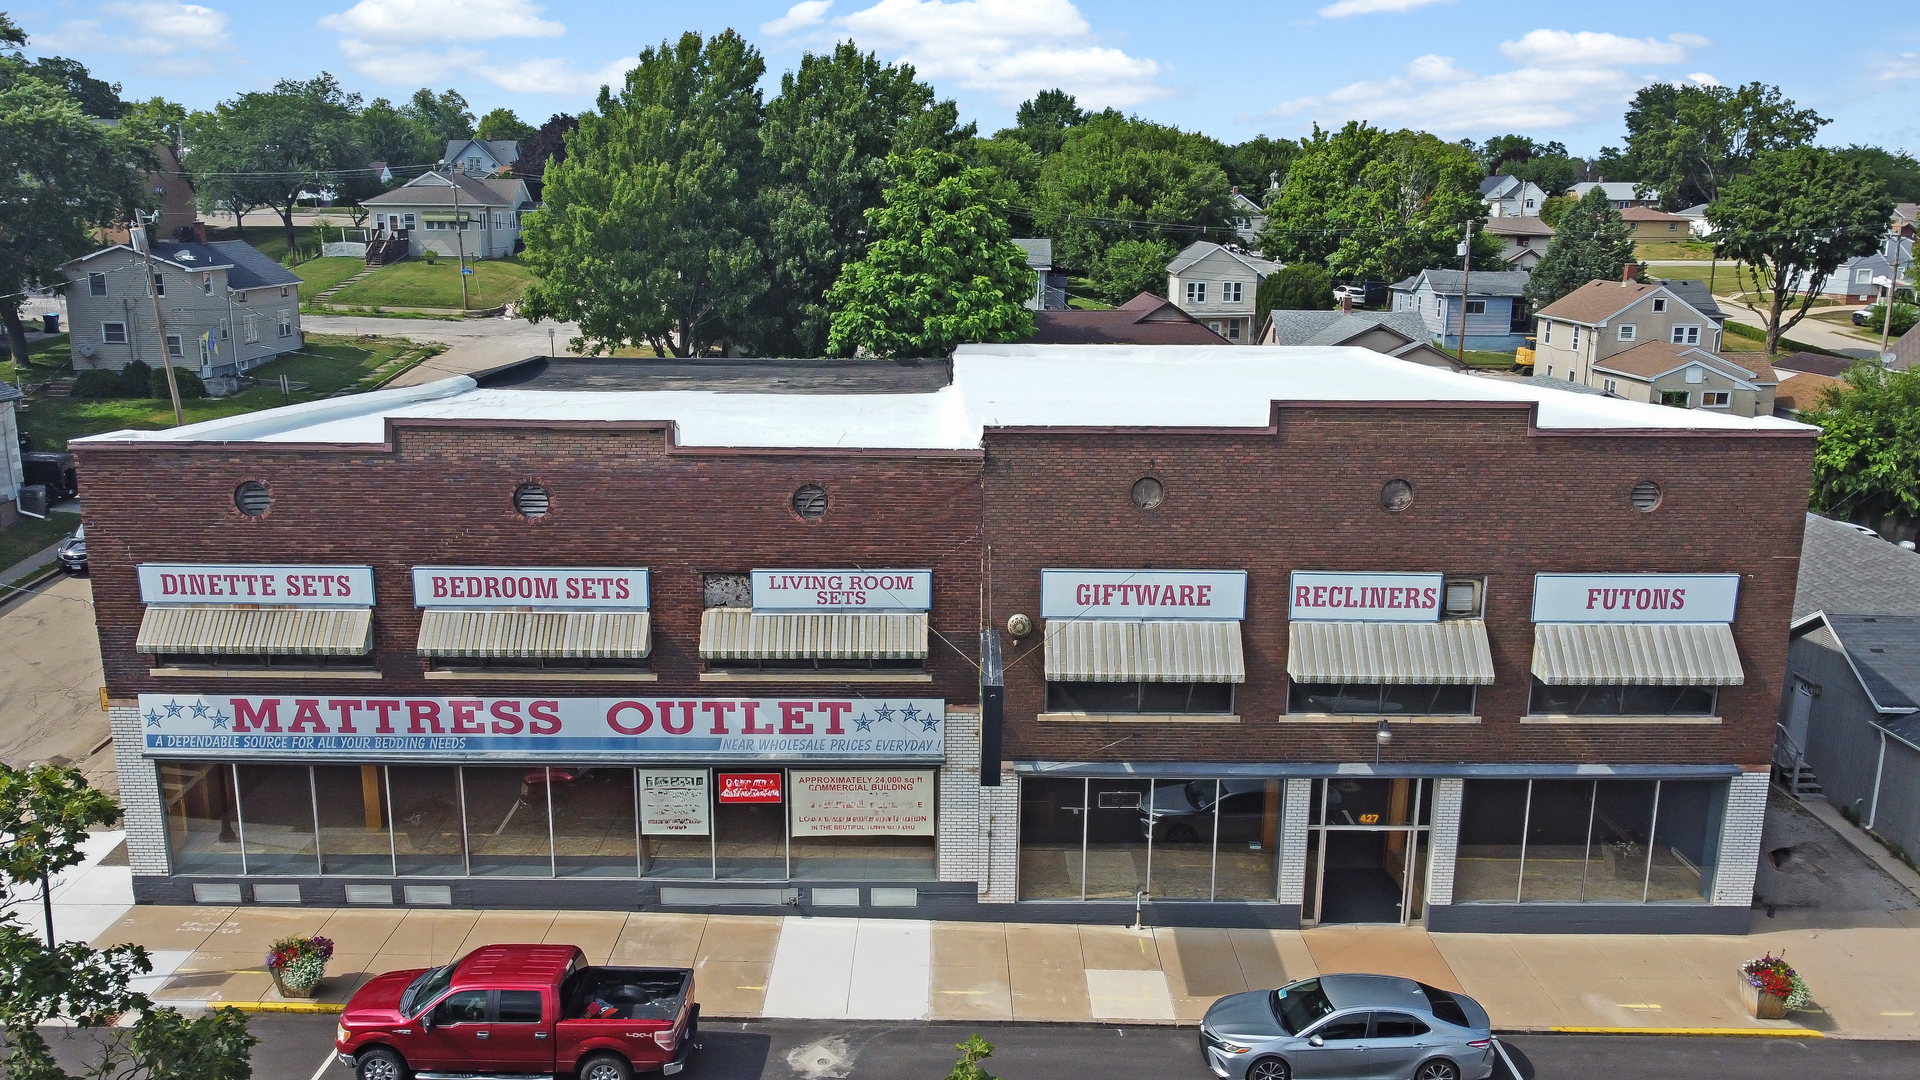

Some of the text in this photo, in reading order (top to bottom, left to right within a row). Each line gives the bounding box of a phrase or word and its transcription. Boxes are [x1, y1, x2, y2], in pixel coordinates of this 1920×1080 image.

[160, 573, 351, 597] DINETTE SETS
[431, 576, 630, 600] BEDROOM SETS
[768, 575, 914, 590] LIVING ROOM
[816, 591, 867, 605] SETS
[1076, 583, 1212, 607] GIFTWARE
[1294, 585, 1437, 609] RECLINERS
[1586, 588, 1686, 610] FUTONS
[229, 698, 852, 736] MATTRESS OUTLET
[155, 735, 467, 750] A DEPENDABLE SOURCE FOR ALL YOUR BEDDING NEEDS
[722, 738, 755, 751] NEAR
[758, 739, 826, 752] WHOLESALE
[829, 739, 871, 752] PRICES
[875, 739, 933, 752] EVERYDAY
[798, 776, 924, 786] APPROXIMATELY 24,000 sq ft
[1358, 813, 1380, 824] 427
